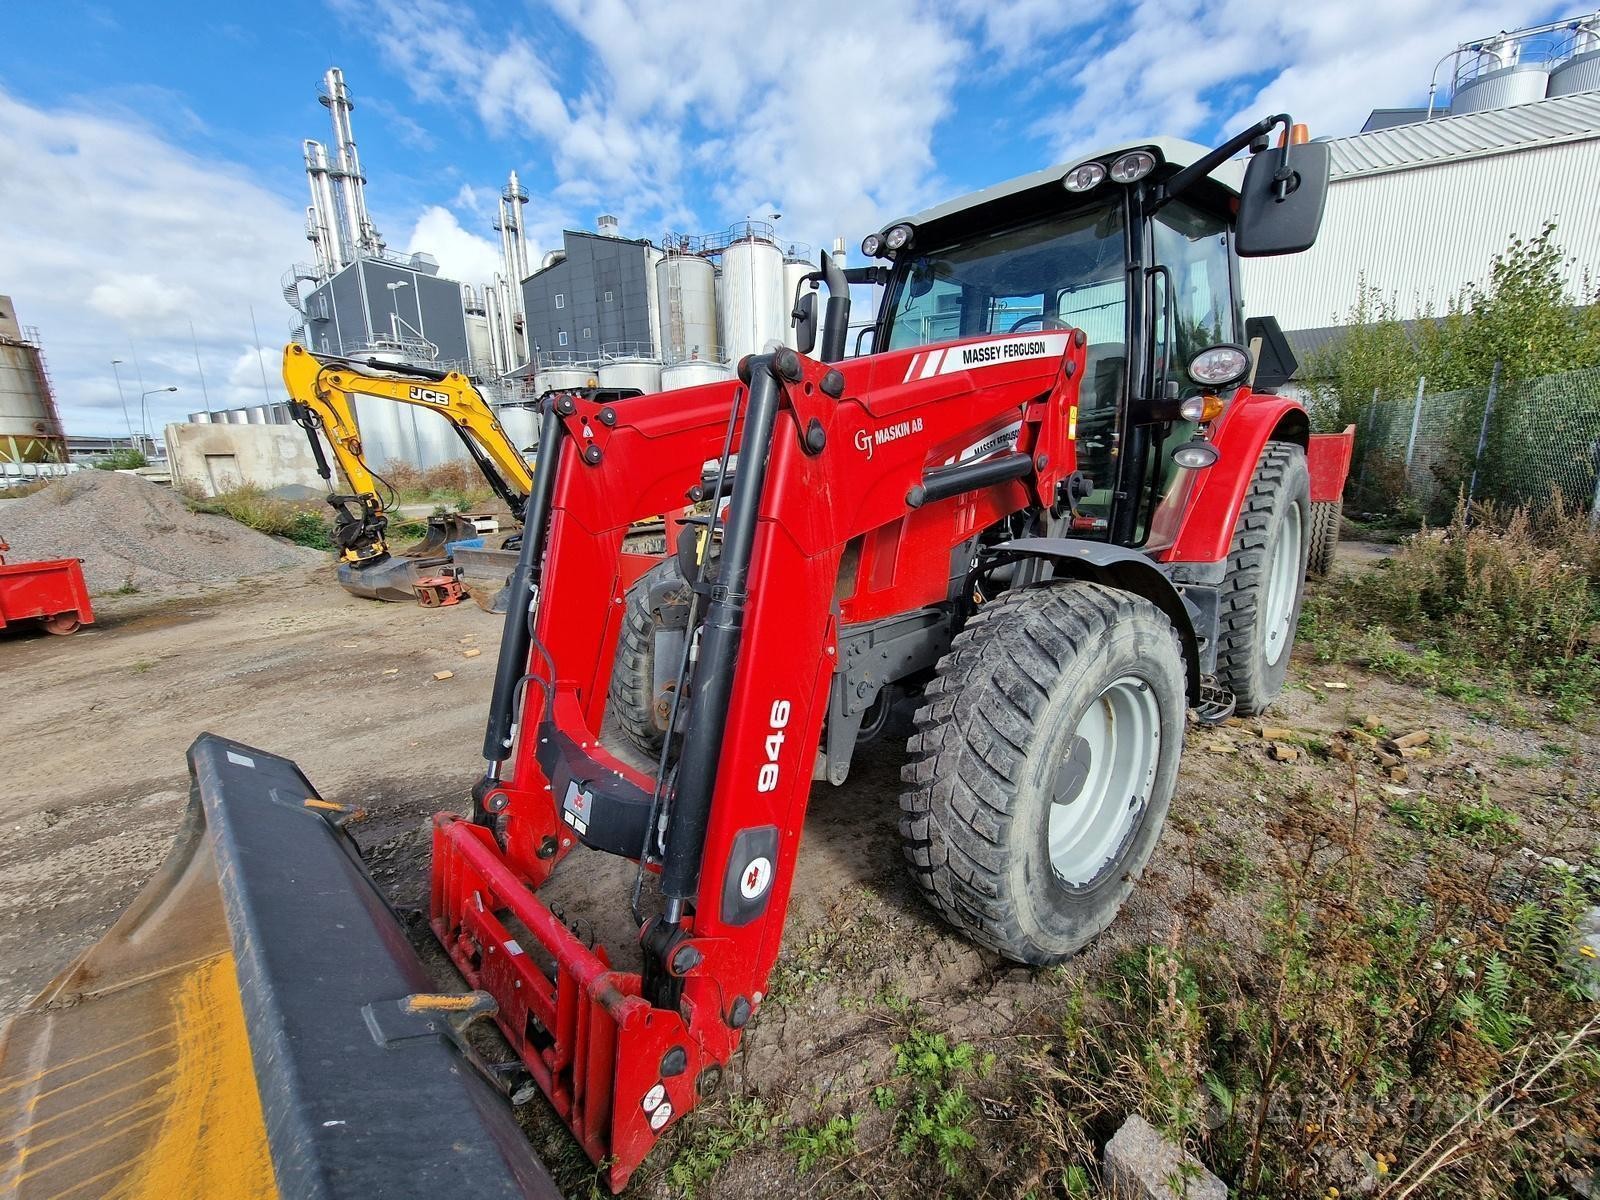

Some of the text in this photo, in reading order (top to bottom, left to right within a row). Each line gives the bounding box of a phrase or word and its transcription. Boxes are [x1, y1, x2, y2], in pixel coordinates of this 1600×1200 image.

[963, 341, 1046, 364] MASSEY FERGUSON
[410, 386, 449, 405] JCB
[874, 421, 910, 446] MASKIN
[911, 417, 924, 434] AB
[996, 428, 1020, 444] FERGUSO
[757, 700, 791, 793] 946
